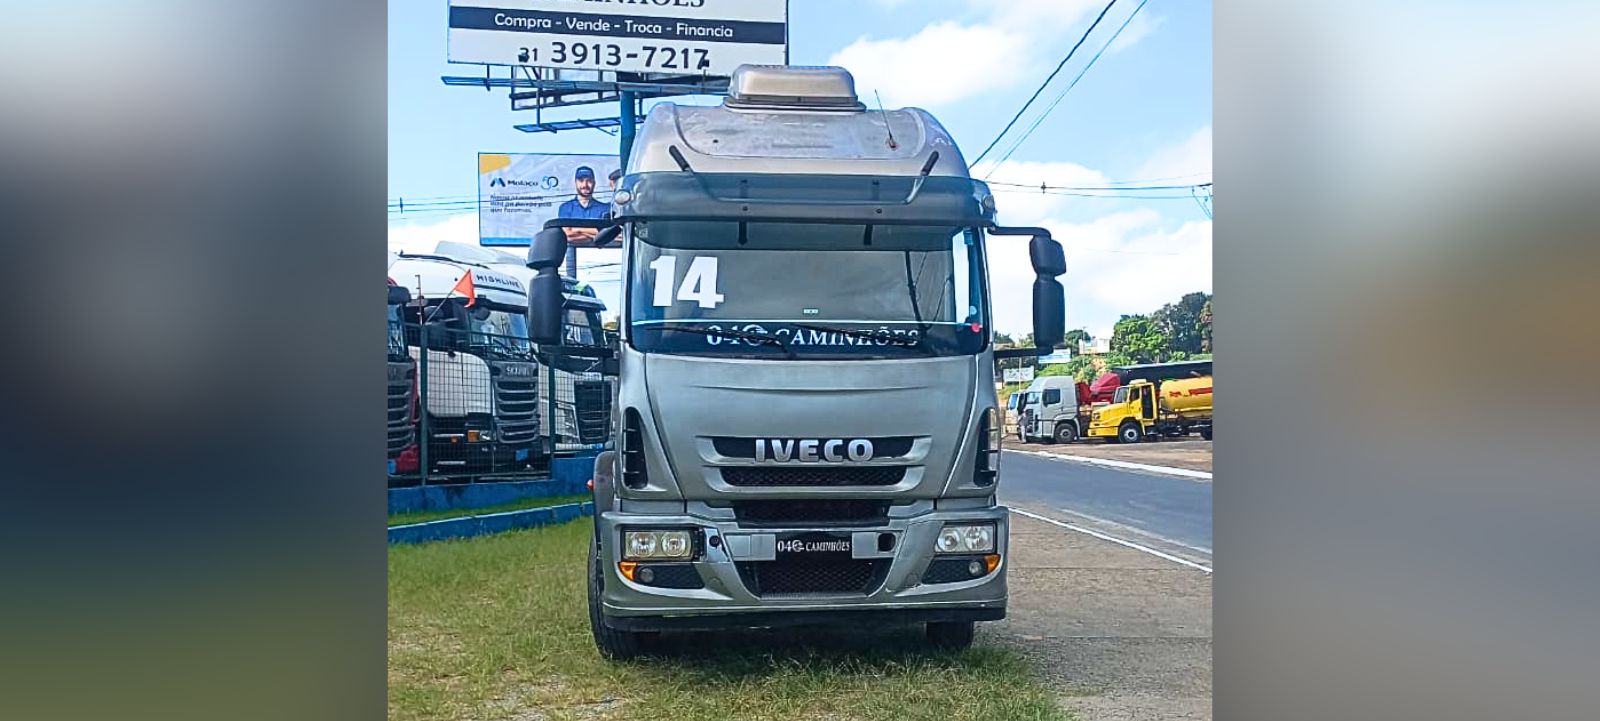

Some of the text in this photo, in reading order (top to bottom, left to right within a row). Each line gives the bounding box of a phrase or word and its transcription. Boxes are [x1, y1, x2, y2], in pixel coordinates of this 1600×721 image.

[494, 13, 552, 29] Compra
[565, 17, 610, 32] Vende
[624, 20, 662, 34] Troca
[676, 23, 734, 38] Financia
[551, 41, 709, 70] 3913-7217
[476, 274, 520, 288] HIGHLINE
[650, 255, 725, 309] 14
[754, 438, 874, 462] IVECO
[805, 539, 850, 552] CAMINHÕES
